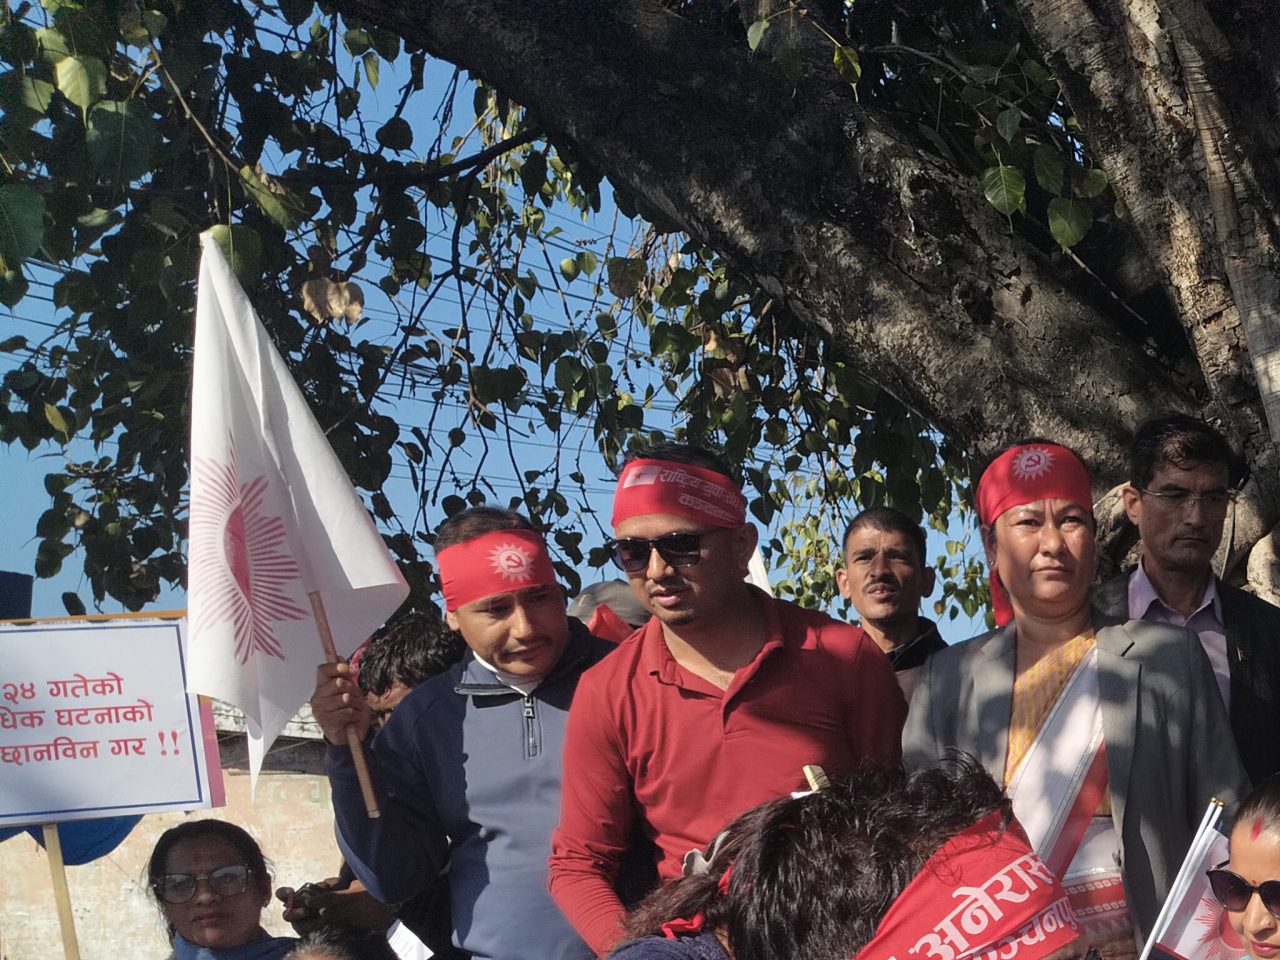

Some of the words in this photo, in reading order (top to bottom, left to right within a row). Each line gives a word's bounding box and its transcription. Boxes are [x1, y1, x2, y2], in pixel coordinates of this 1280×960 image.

[3, 682, 36, 704] २४
[47, 672, 124, 698] गतेको
[55, 699, 154, 726] घटनाको
[109, 738, 146, 756] गर
